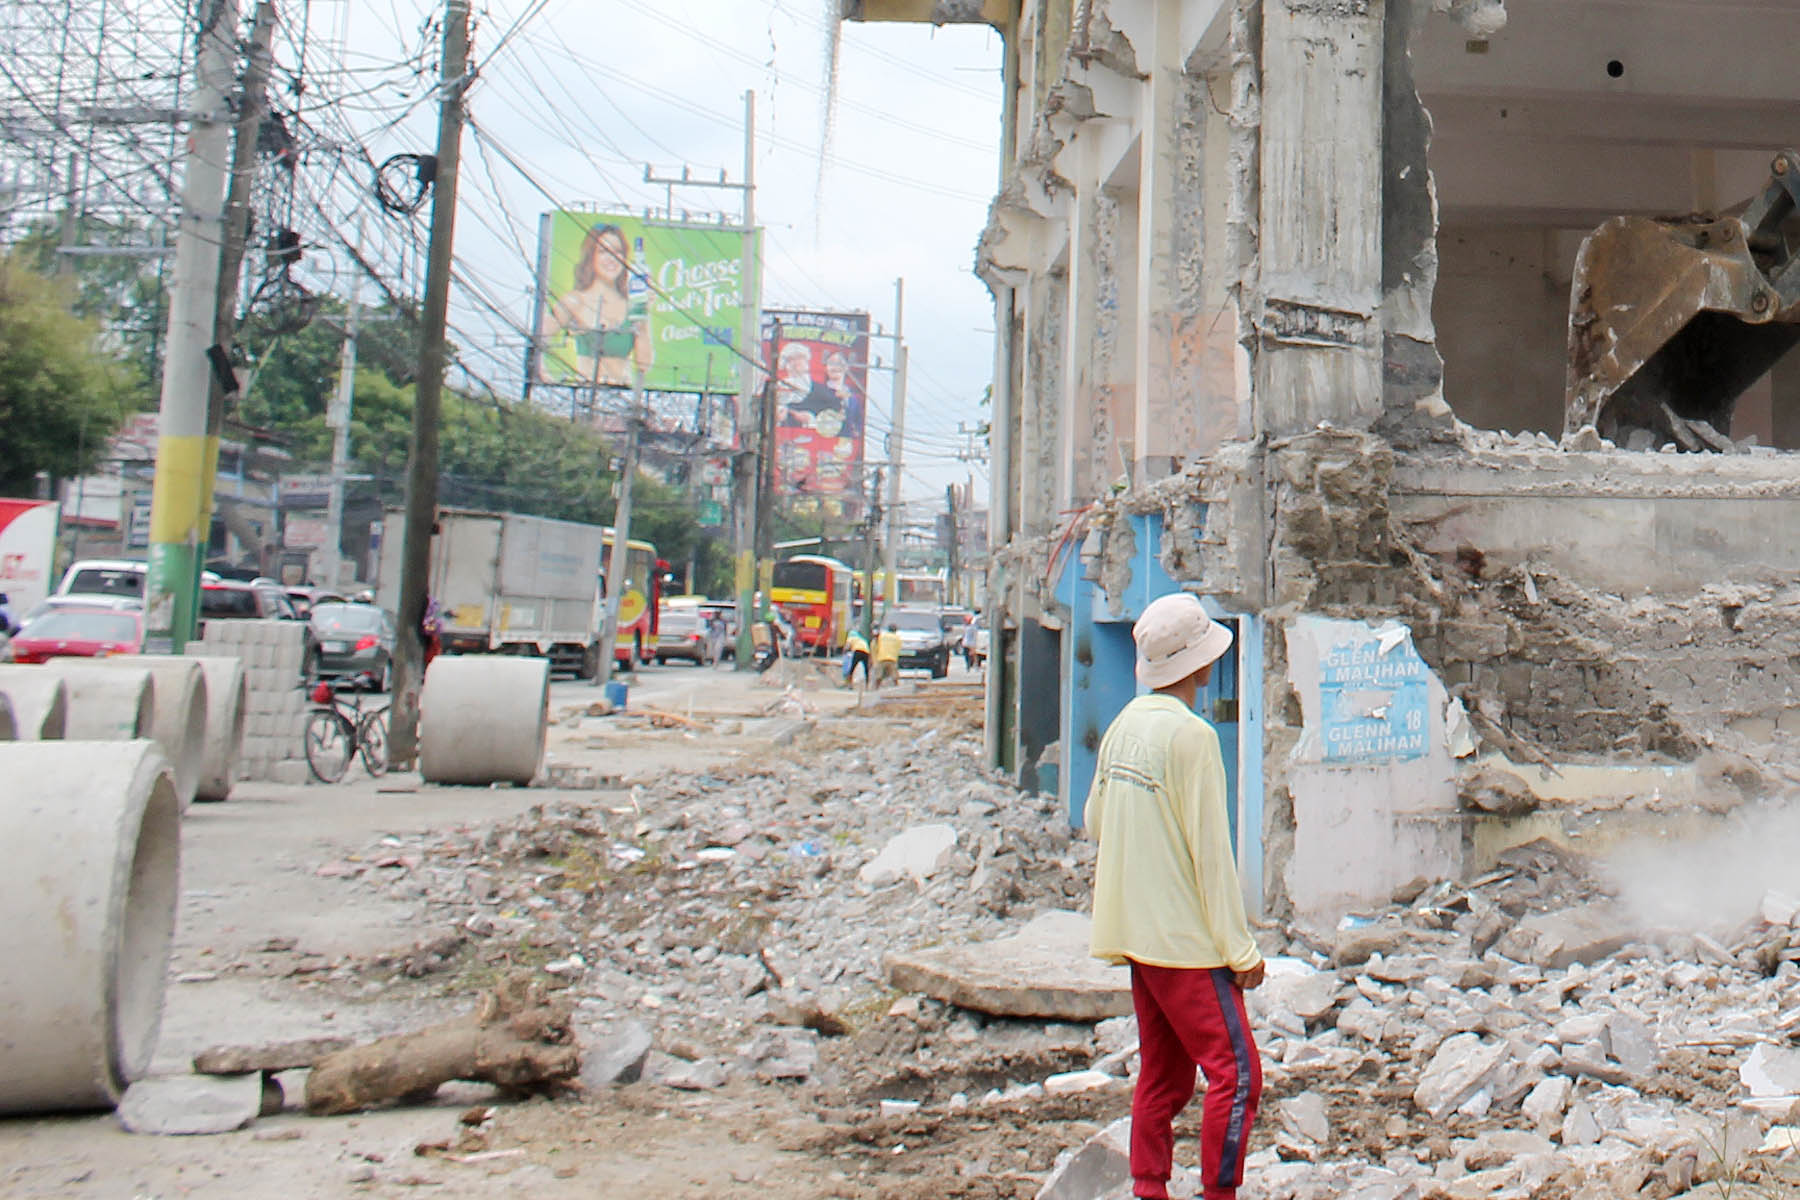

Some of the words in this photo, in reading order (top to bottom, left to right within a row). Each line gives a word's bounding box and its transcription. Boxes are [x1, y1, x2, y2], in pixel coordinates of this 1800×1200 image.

[658, 257, 742, 293] Choose
[1336, 661, 1420, 682] MALIHAN
[1406, 709, 1422, 731] 18
[1328, 722, 1392, 742] GLENN
[1338, 733, 1423, 756] MALIHAN
